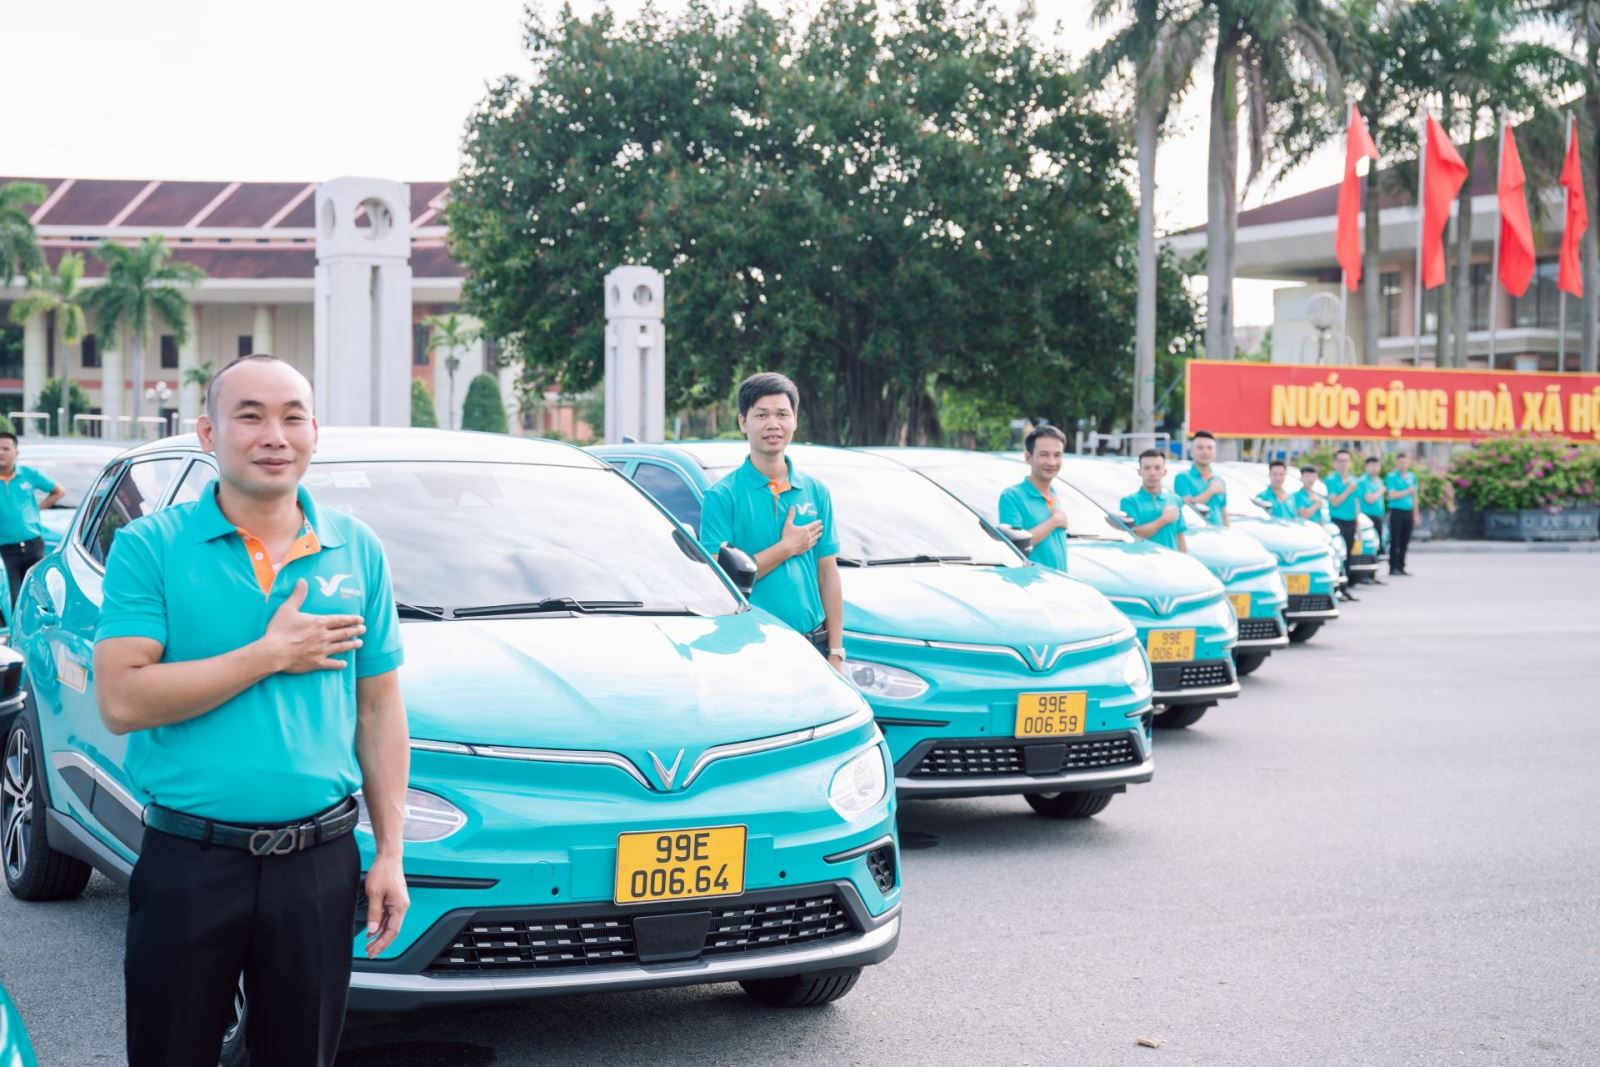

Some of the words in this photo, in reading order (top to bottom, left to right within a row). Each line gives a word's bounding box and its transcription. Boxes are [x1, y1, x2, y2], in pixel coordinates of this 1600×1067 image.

[1271, 372, 1360, 429] NƯỚC
[1365, 380, 1448, 437] CỘNG
[1454, 383, 1515, 431] HOÀ
[1522, 384, 1564, 432] XÃ
[1039, 695, 1067, 713] 99E
[1024, 715, 1078, 734] 006.59
[656, 833, 710, 863] 99E
[631, 864, 729, 897] 006.64
